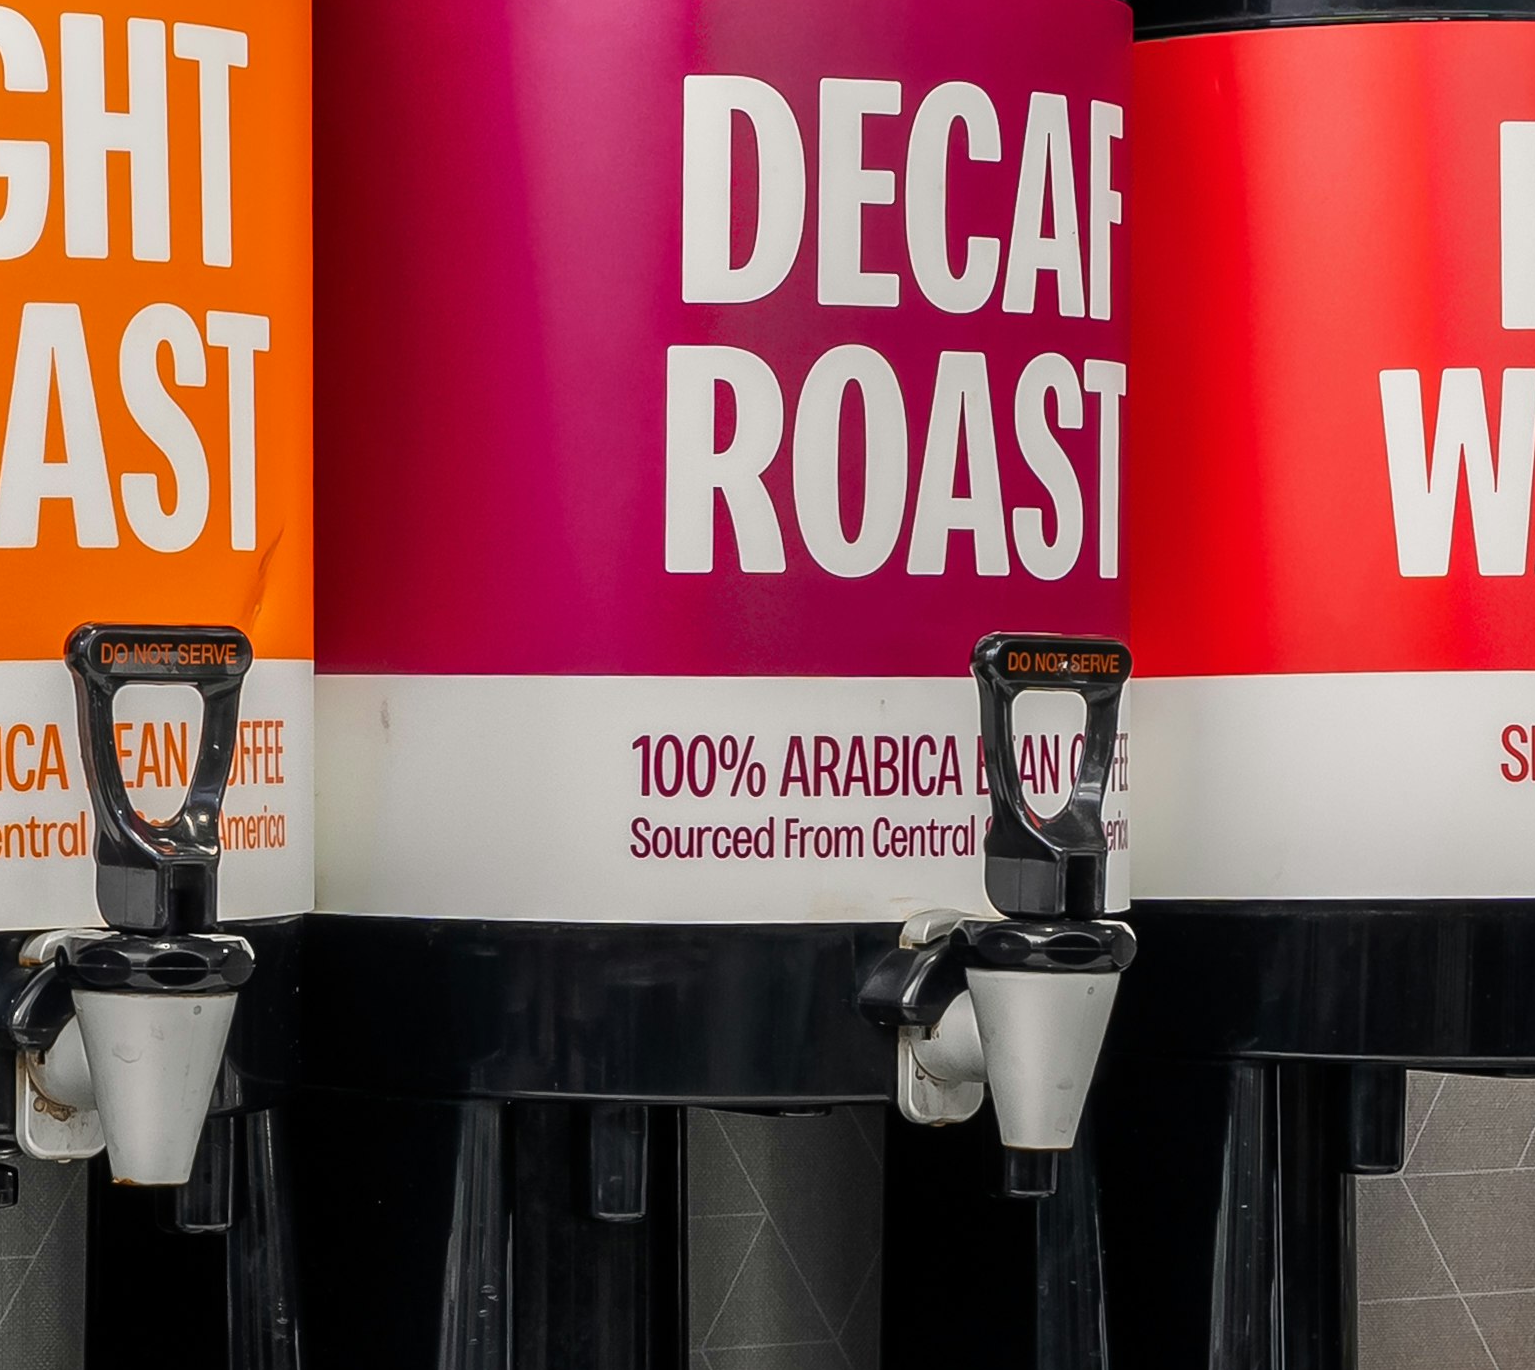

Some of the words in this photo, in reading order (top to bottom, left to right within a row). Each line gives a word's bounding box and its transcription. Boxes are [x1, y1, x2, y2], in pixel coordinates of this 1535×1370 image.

[682, 75, 1123, 320] DECAF
[665, 343, 1126, 580] ROAST
[101, 643, 128, 663] DO
[134, 643, 173, 664] NOT
[177, 644, 237, 665] SERVE
[1008, 652, 1031, 671] DO
[1035, 653, 1067, 672] NOT
[1071, 653, 1120, 673] SERVE
[101, 722, 188, 788] EAN
[631, 734, 767, 798] 100%
[780, 734, 963, 797] ARABICA
[631, 816, 774, 860] Sourced
[785, 817, 863, 859] From
[873, 814, 975, 858] Central
